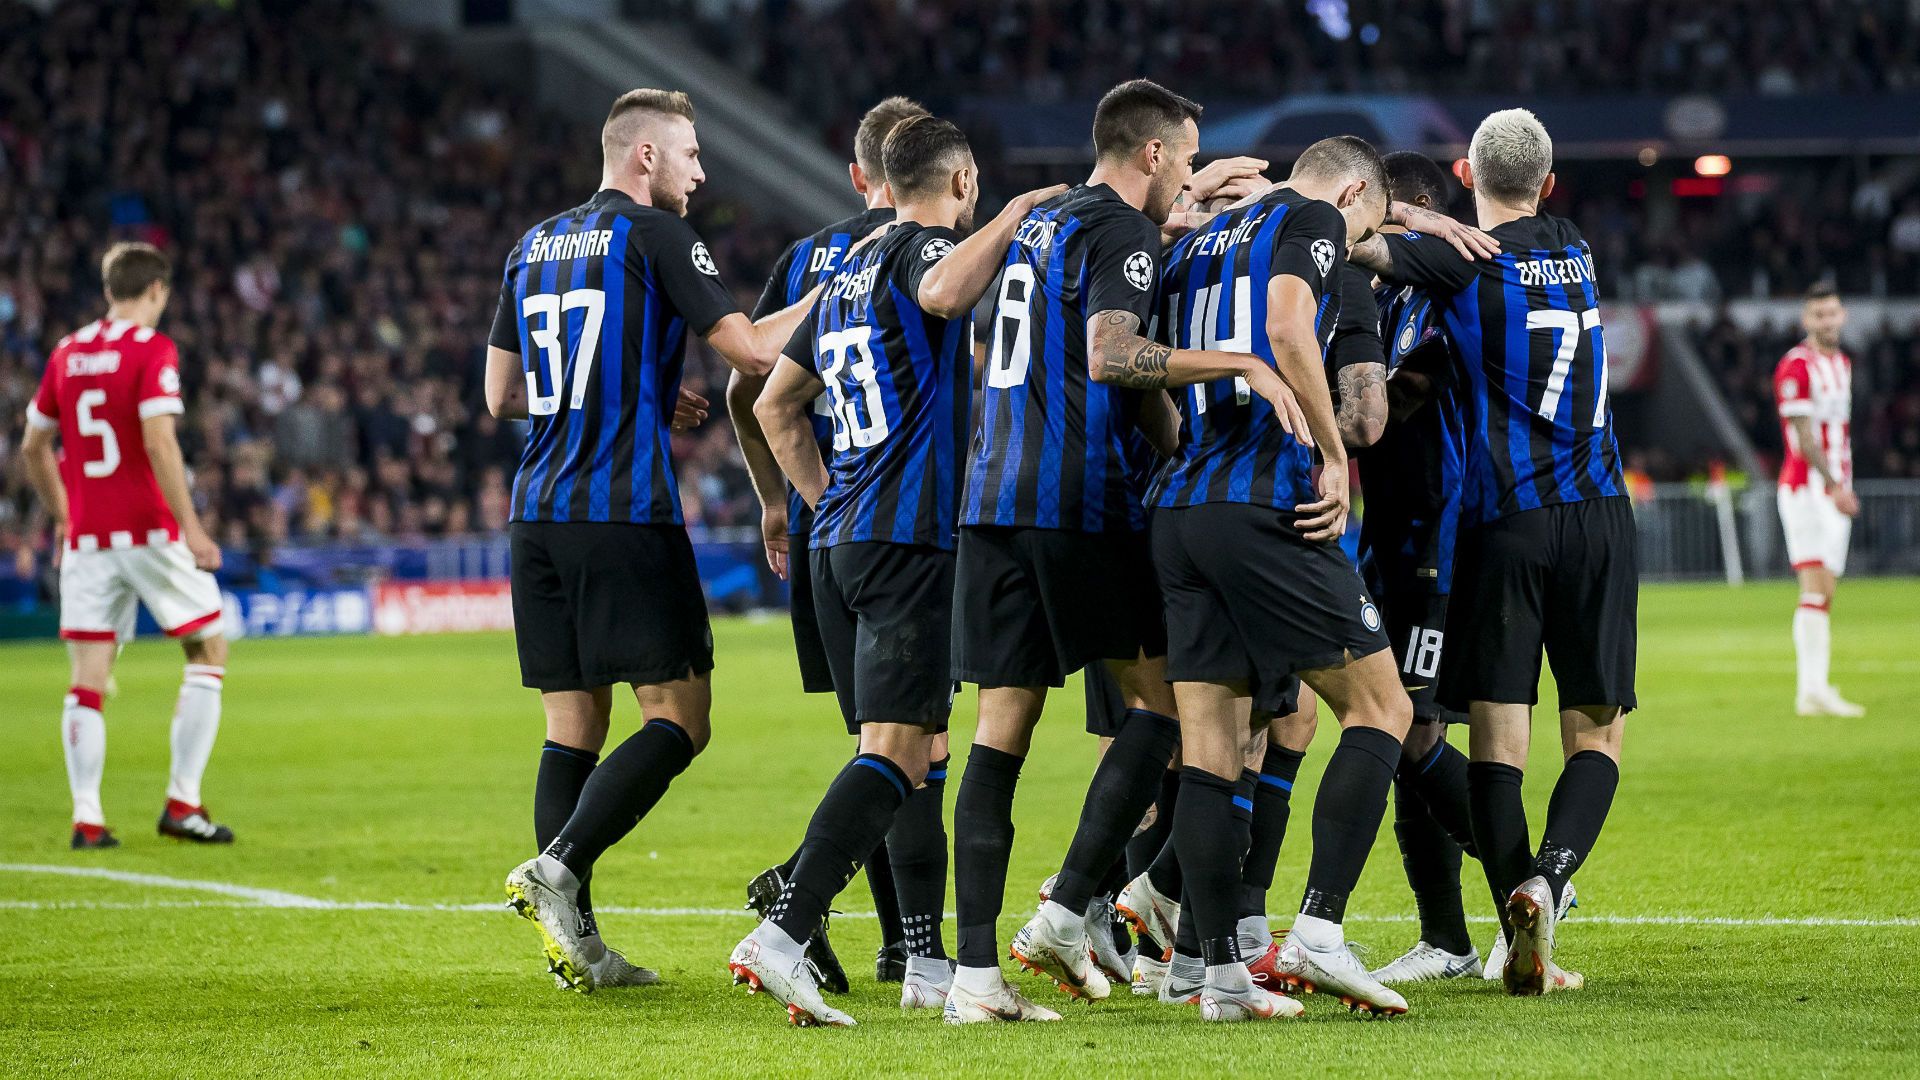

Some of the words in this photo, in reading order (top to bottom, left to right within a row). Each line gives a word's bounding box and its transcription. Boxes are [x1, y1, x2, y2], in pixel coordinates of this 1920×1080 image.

[526, 230, 613, 263] ŠKRINIAR
[810, 246, 842, 272] DE
[522, 289, 605, 415] 37
[988, 263, 1035, 388] 8
[1526, 308, 1609, 428] 77
[76, 388, 121, 478] 5
[819, 326, 888, 451] 33
[1403, 626, 1443, 678] 18
